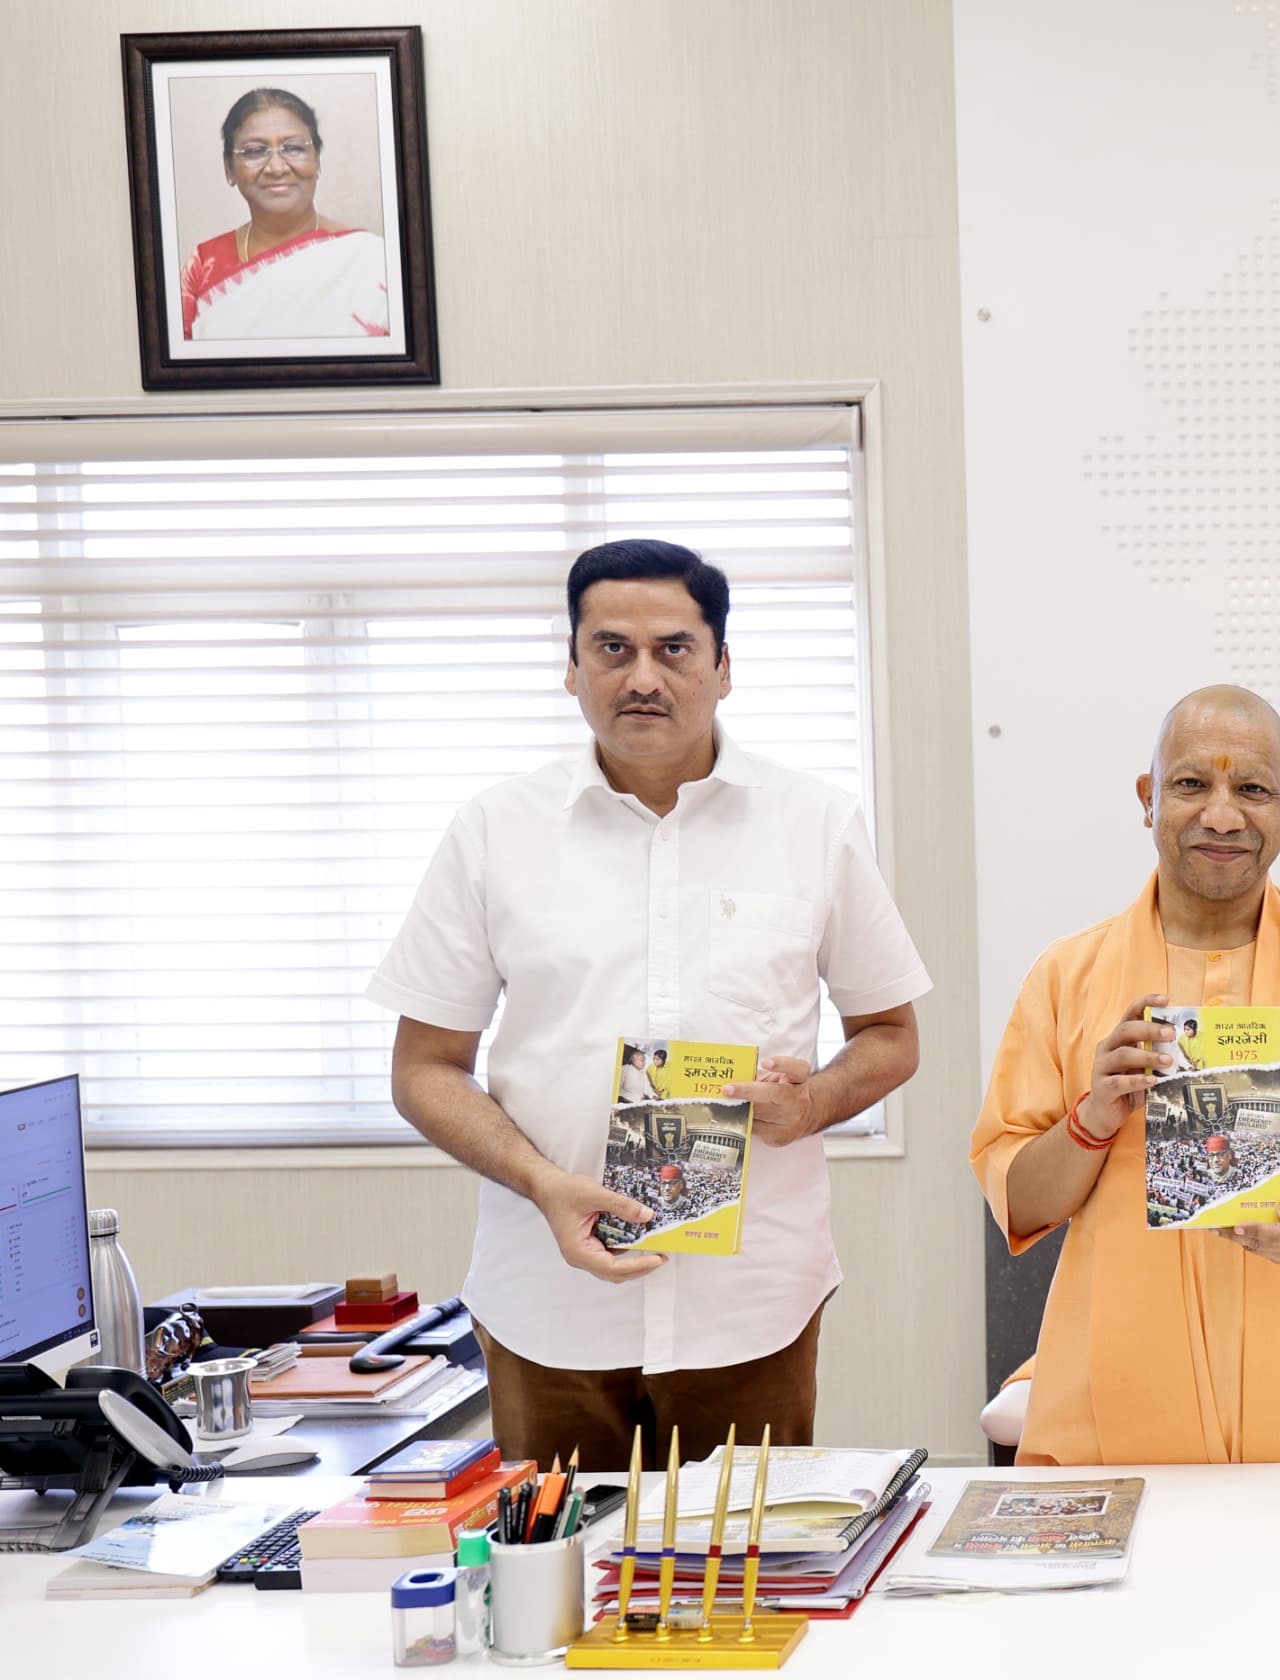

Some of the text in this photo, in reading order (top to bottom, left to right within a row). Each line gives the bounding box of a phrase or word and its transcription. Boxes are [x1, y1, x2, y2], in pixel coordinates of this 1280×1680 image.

[1216, 1031, 1268, 1045] इमरजेंसी
[1230, 1050, 1258, 1061] 1975
[694, 1082, 722, 1095] 1975
